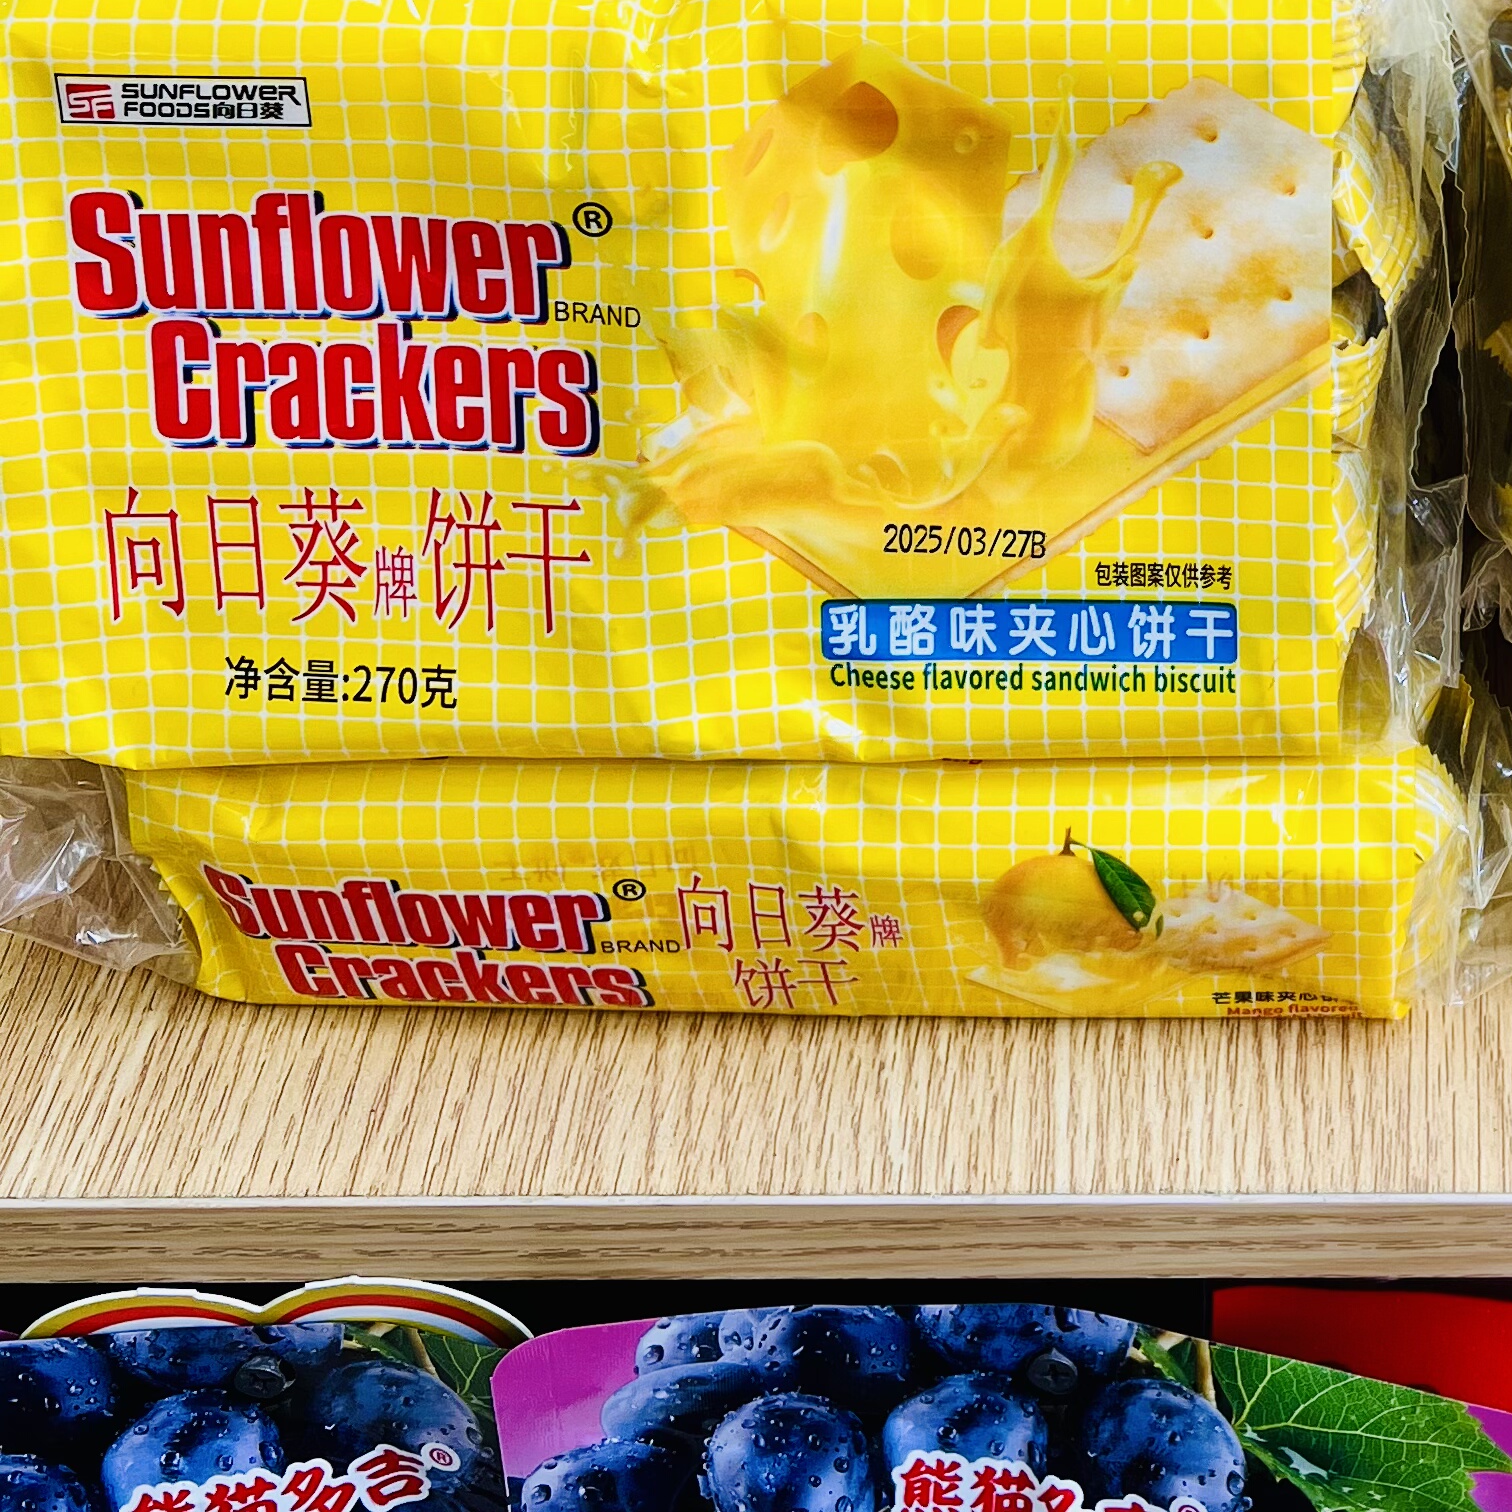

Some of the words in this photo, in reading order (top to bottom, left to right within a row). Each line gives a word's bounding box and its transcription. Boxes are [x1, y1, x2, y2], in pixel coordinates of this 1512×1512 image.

[121, 82, 302, 106] SUNFLOWER
[67, 188, 572, 323] Sunflower
[554, 301, 641, 328] BRAND
[149, 316, 601, 455] Crackers
[104, 485, 591, 634] 向日葵牌饼干
[881, 522, 1048, 560] 2025/03/27B
[1094, 561, 1235, 592] 包装图案仅供参考
[826, 602, 1236, 659] 乳酪味夹心饼干
[224, 656, 459, 710] 净含量:270克
[830, 663, 916, 691] Cheese
[922, 663, 1025, 692] flavored
[1031, 664, 1147, 693] sandwich
[1153, 666, 1237, 695] biscuit
[201, 864, 611, 955] Sunflower
[676, 875, 904, 953] 向日葵牌
[601, 940, 682, 954] BRAND
[272, 943, 653, 1007] Crackers
[734, 957, 859, 1010] 饼干
[1211, 991, 1340, 1004] 芒果味夹心
[1227, 1007, 1284, 1017] Mango
[900, 1458, 1148, 1512] 熊猫
